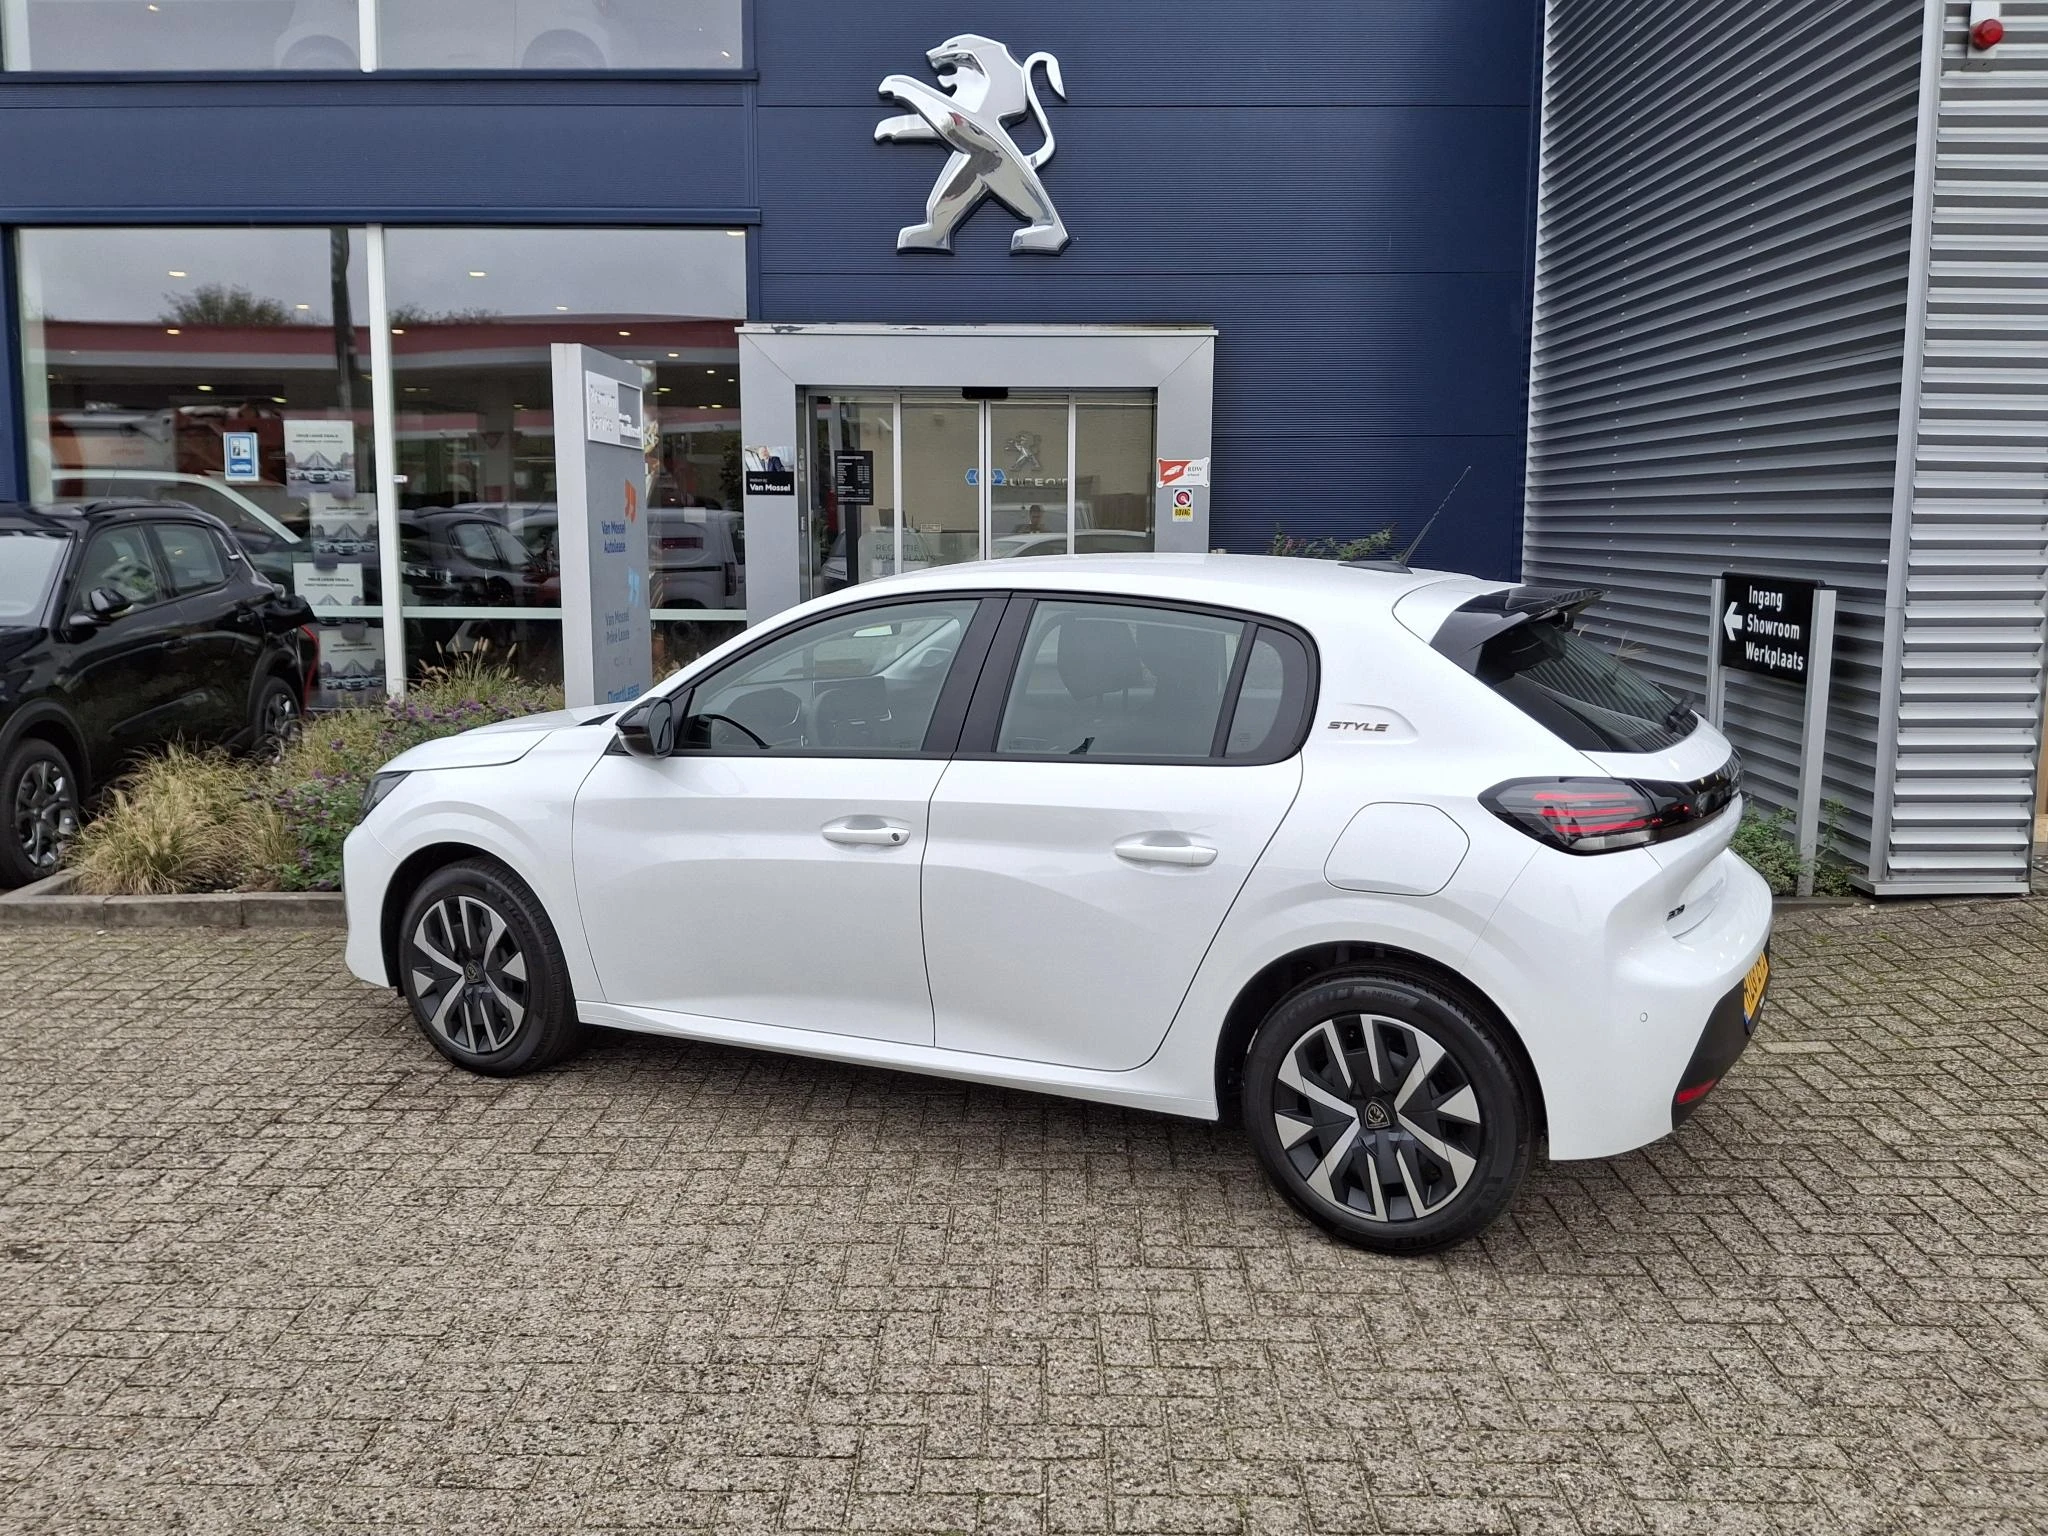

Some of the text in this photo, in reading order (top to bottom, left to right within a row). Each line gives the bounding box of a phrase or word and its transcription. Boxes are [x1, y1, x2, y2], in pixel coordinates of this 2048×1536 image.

[765, 483, 791, 491] Mossel
[1174, 508, 1191, 516] BOVAG
[601, 519, 626, 535] Van Mossel
[604, 538, 626, 553] Autolease
[1748, 585, 1783, 612] Ingang
[605, 612, 615, 626] Van
[1746, 613, 1800, 640] Showroom
[1745, 641, 1804, 671] Werkplaats
[1327, 721, 1389, 732] STYLE
